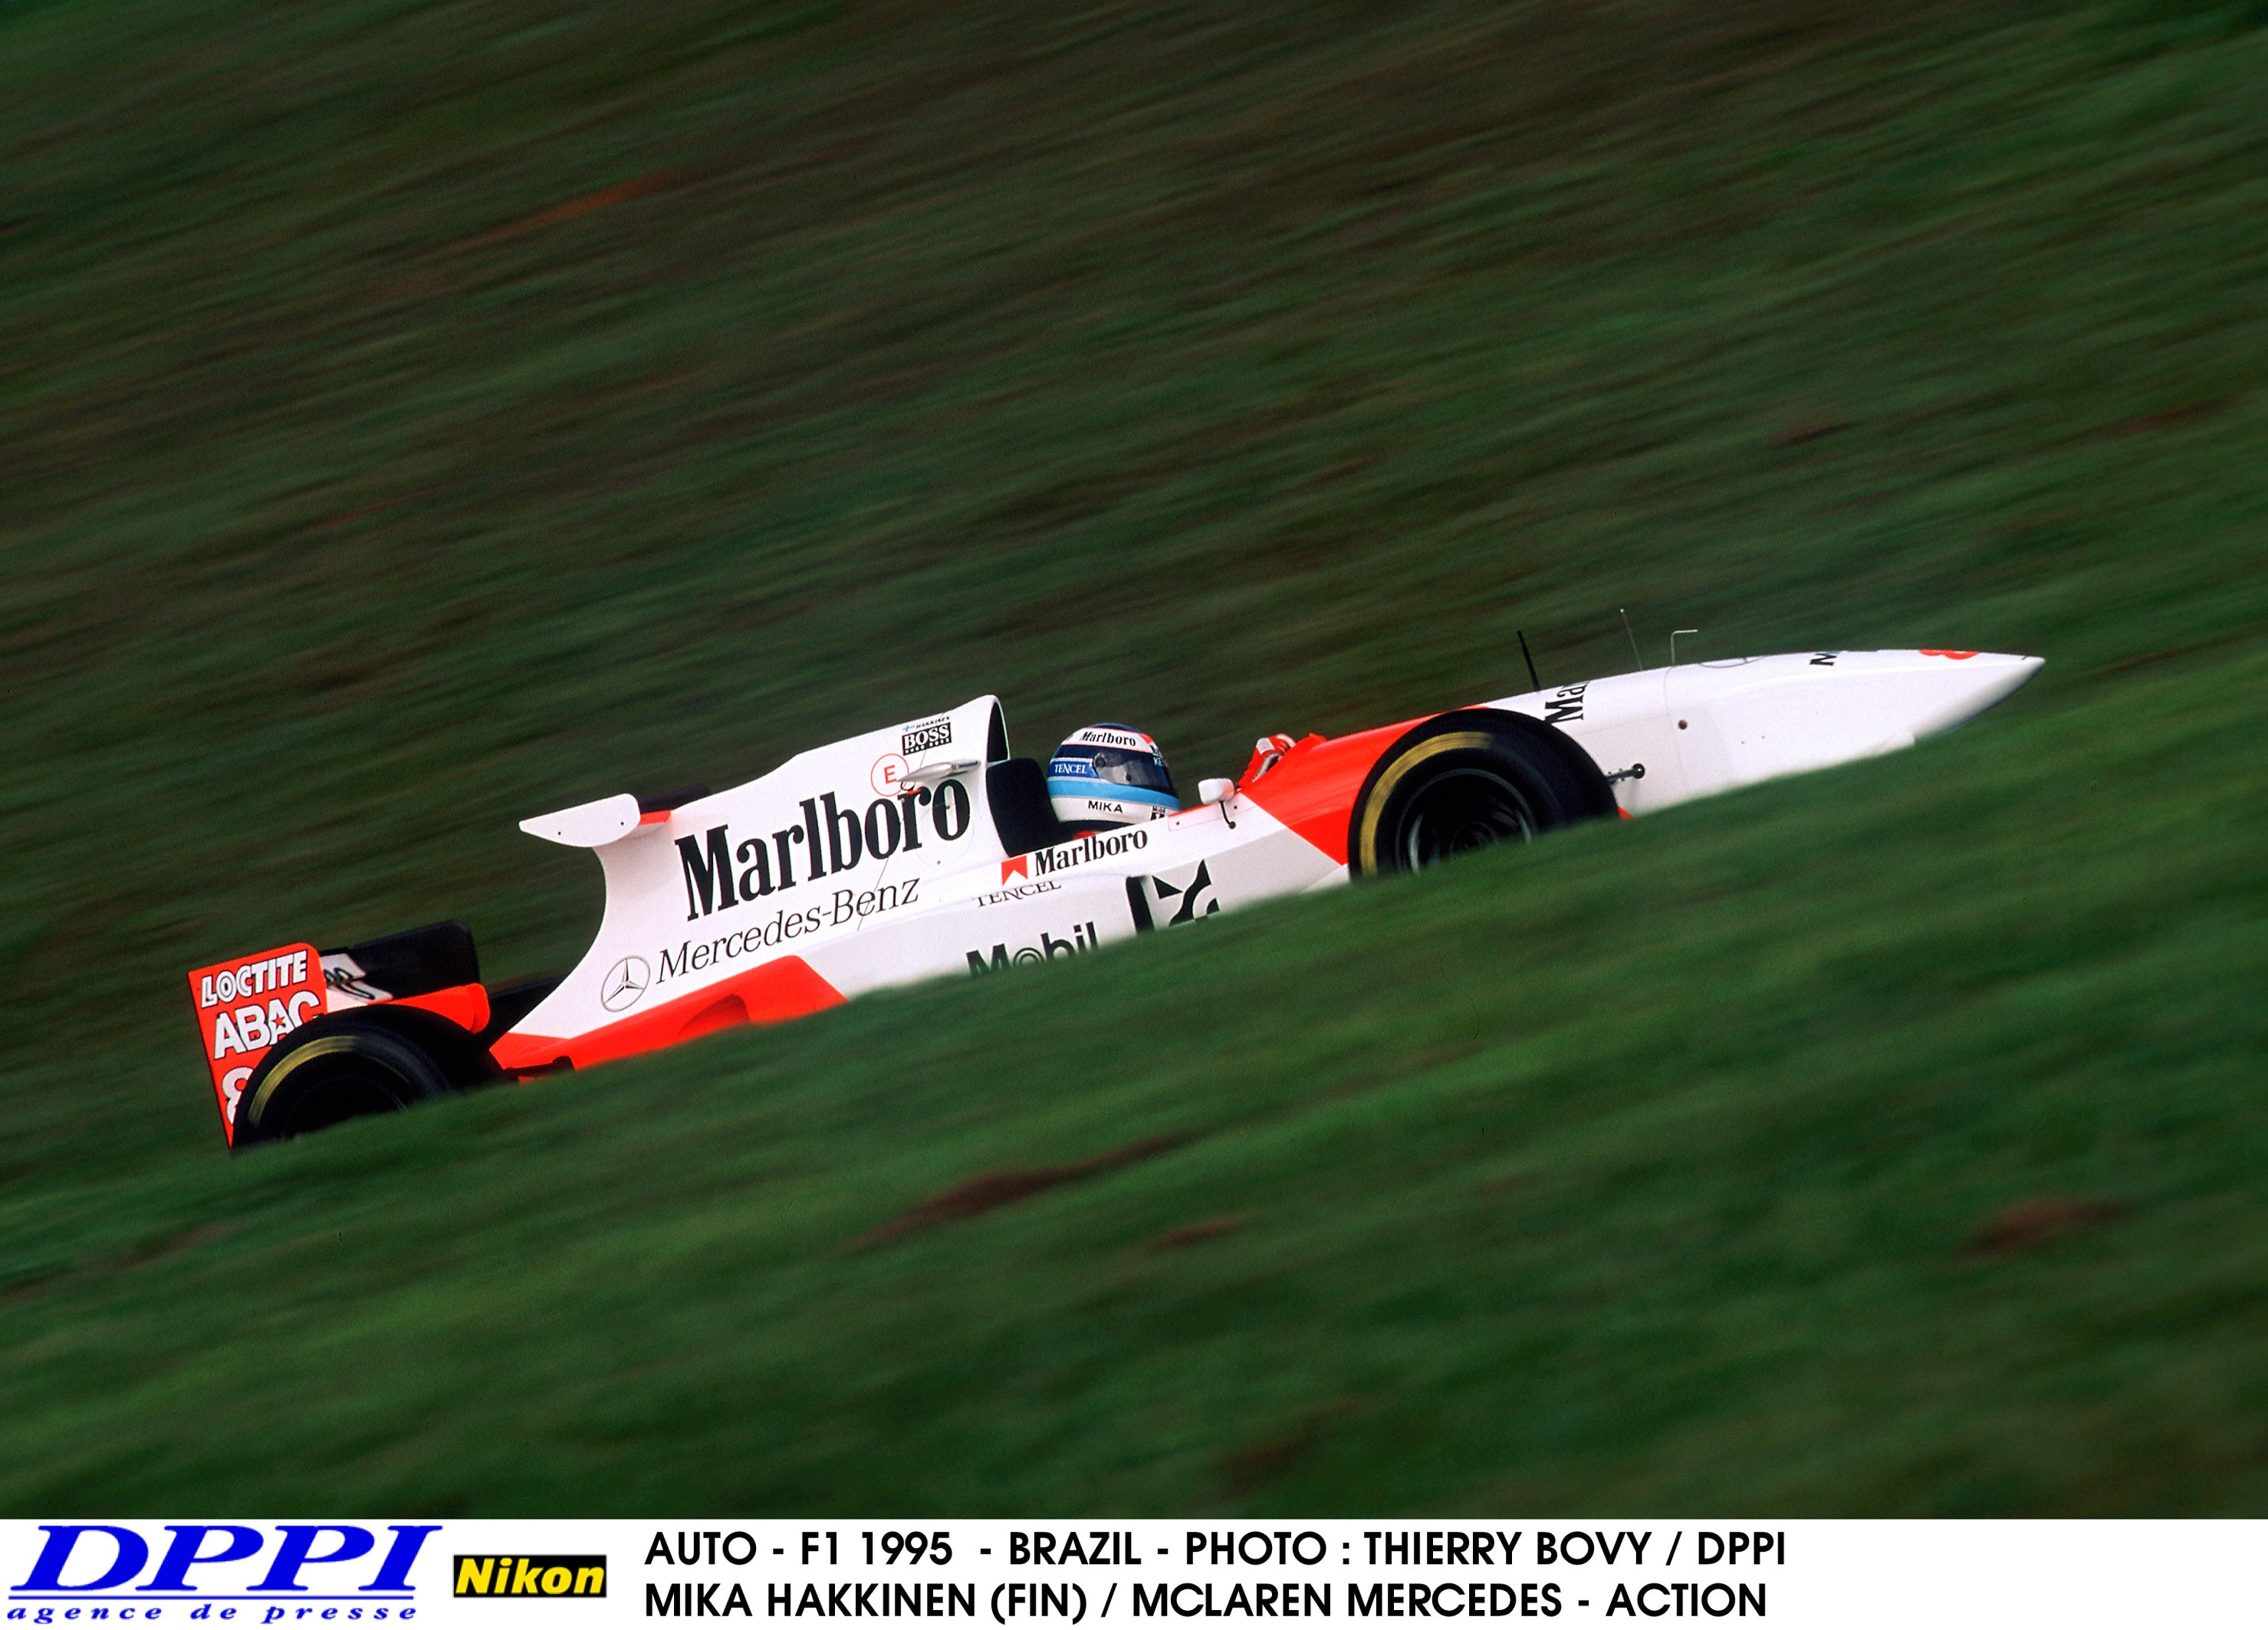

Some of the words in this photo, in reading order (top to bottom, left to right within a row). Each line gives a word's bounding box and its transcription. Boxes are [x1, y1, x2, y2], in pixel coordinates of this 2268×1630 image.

[904, 725, 950, 749] BOSS
[1080, 731, 1136, 748] Marlboro
[884, 765, 898, 784] E
[1054, 764, 1087, 774] TENCEL
[1088, 800, 1123, 813] MIKA
[675, 778, 971, 923] Marlboro
[1035, 829, 1149, 877] Marlboro
[974, 880, 1062, 908] TENCEL
[656, 877, 921, 984] Mercedes-Benz
[965, 921, 1099, 978] Mobil
[201, 950, 307, 1009] LOCTITE
[214, 990, 321, 1060] ABAC
